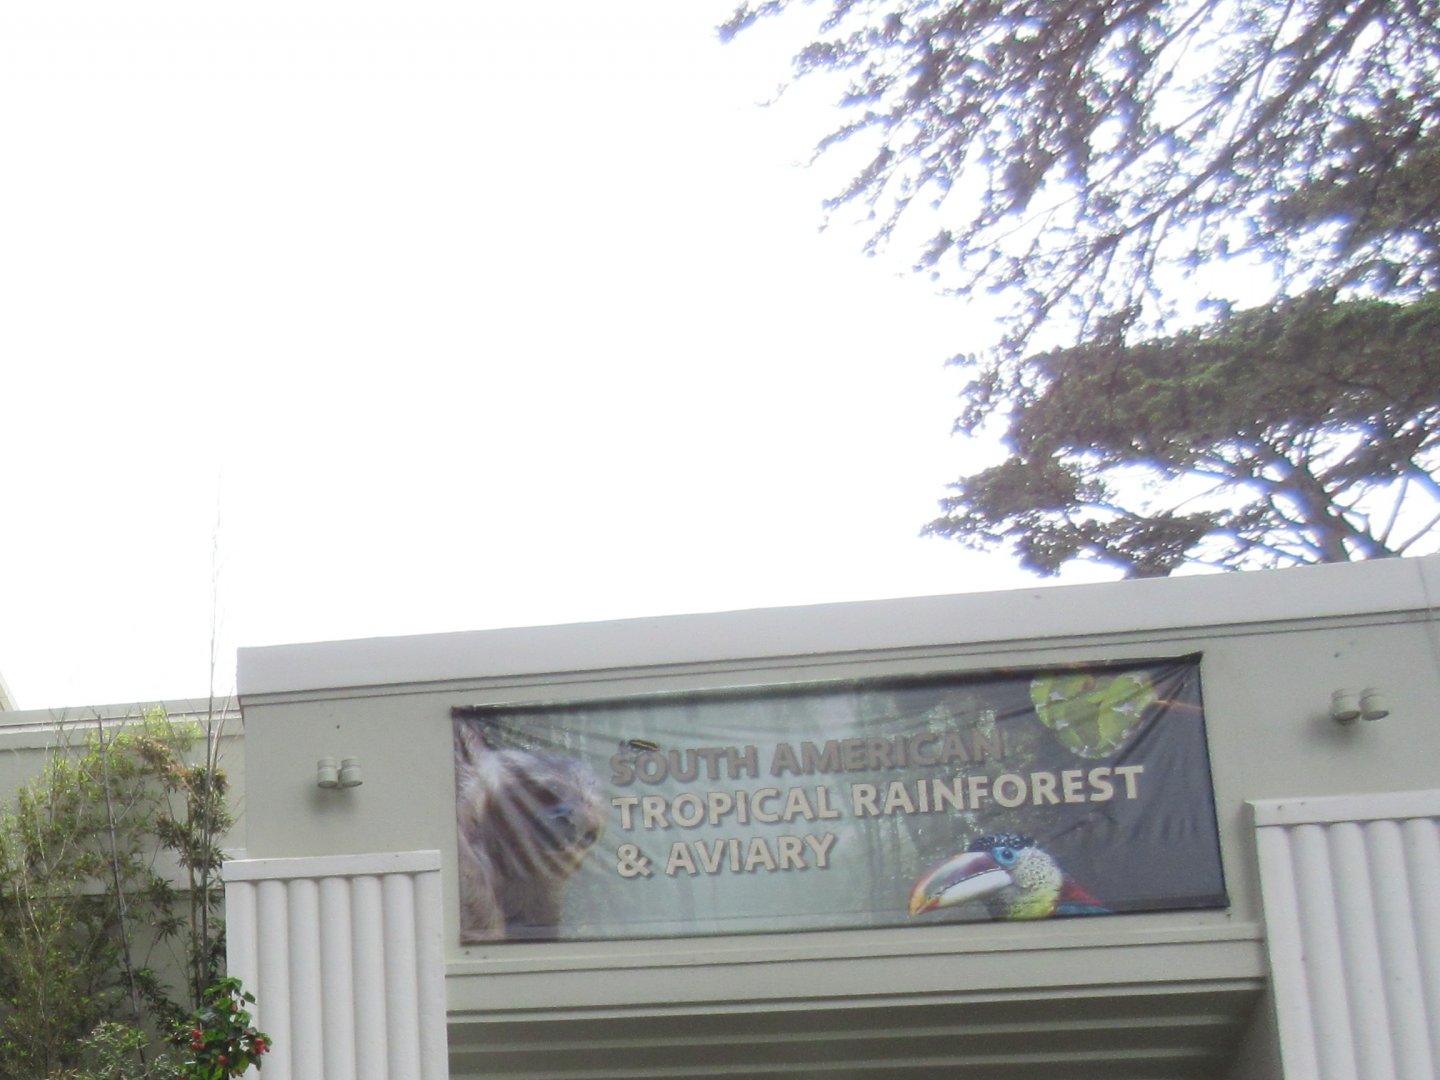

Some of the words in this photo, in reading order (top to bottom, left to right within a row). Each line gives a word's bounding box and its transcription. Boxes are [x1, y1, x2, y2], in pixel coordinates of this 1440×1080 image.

[610, 744, 759, 786] SOUTH
[769, 727, 1004, 777] AMERICAN
[611, 784, 840, 830] TROPICAL
[852, 764, 1145, 817] RAINFOREST
[616, 843, 651, 878] &
[665, 831, 835, 876] AVIARY
